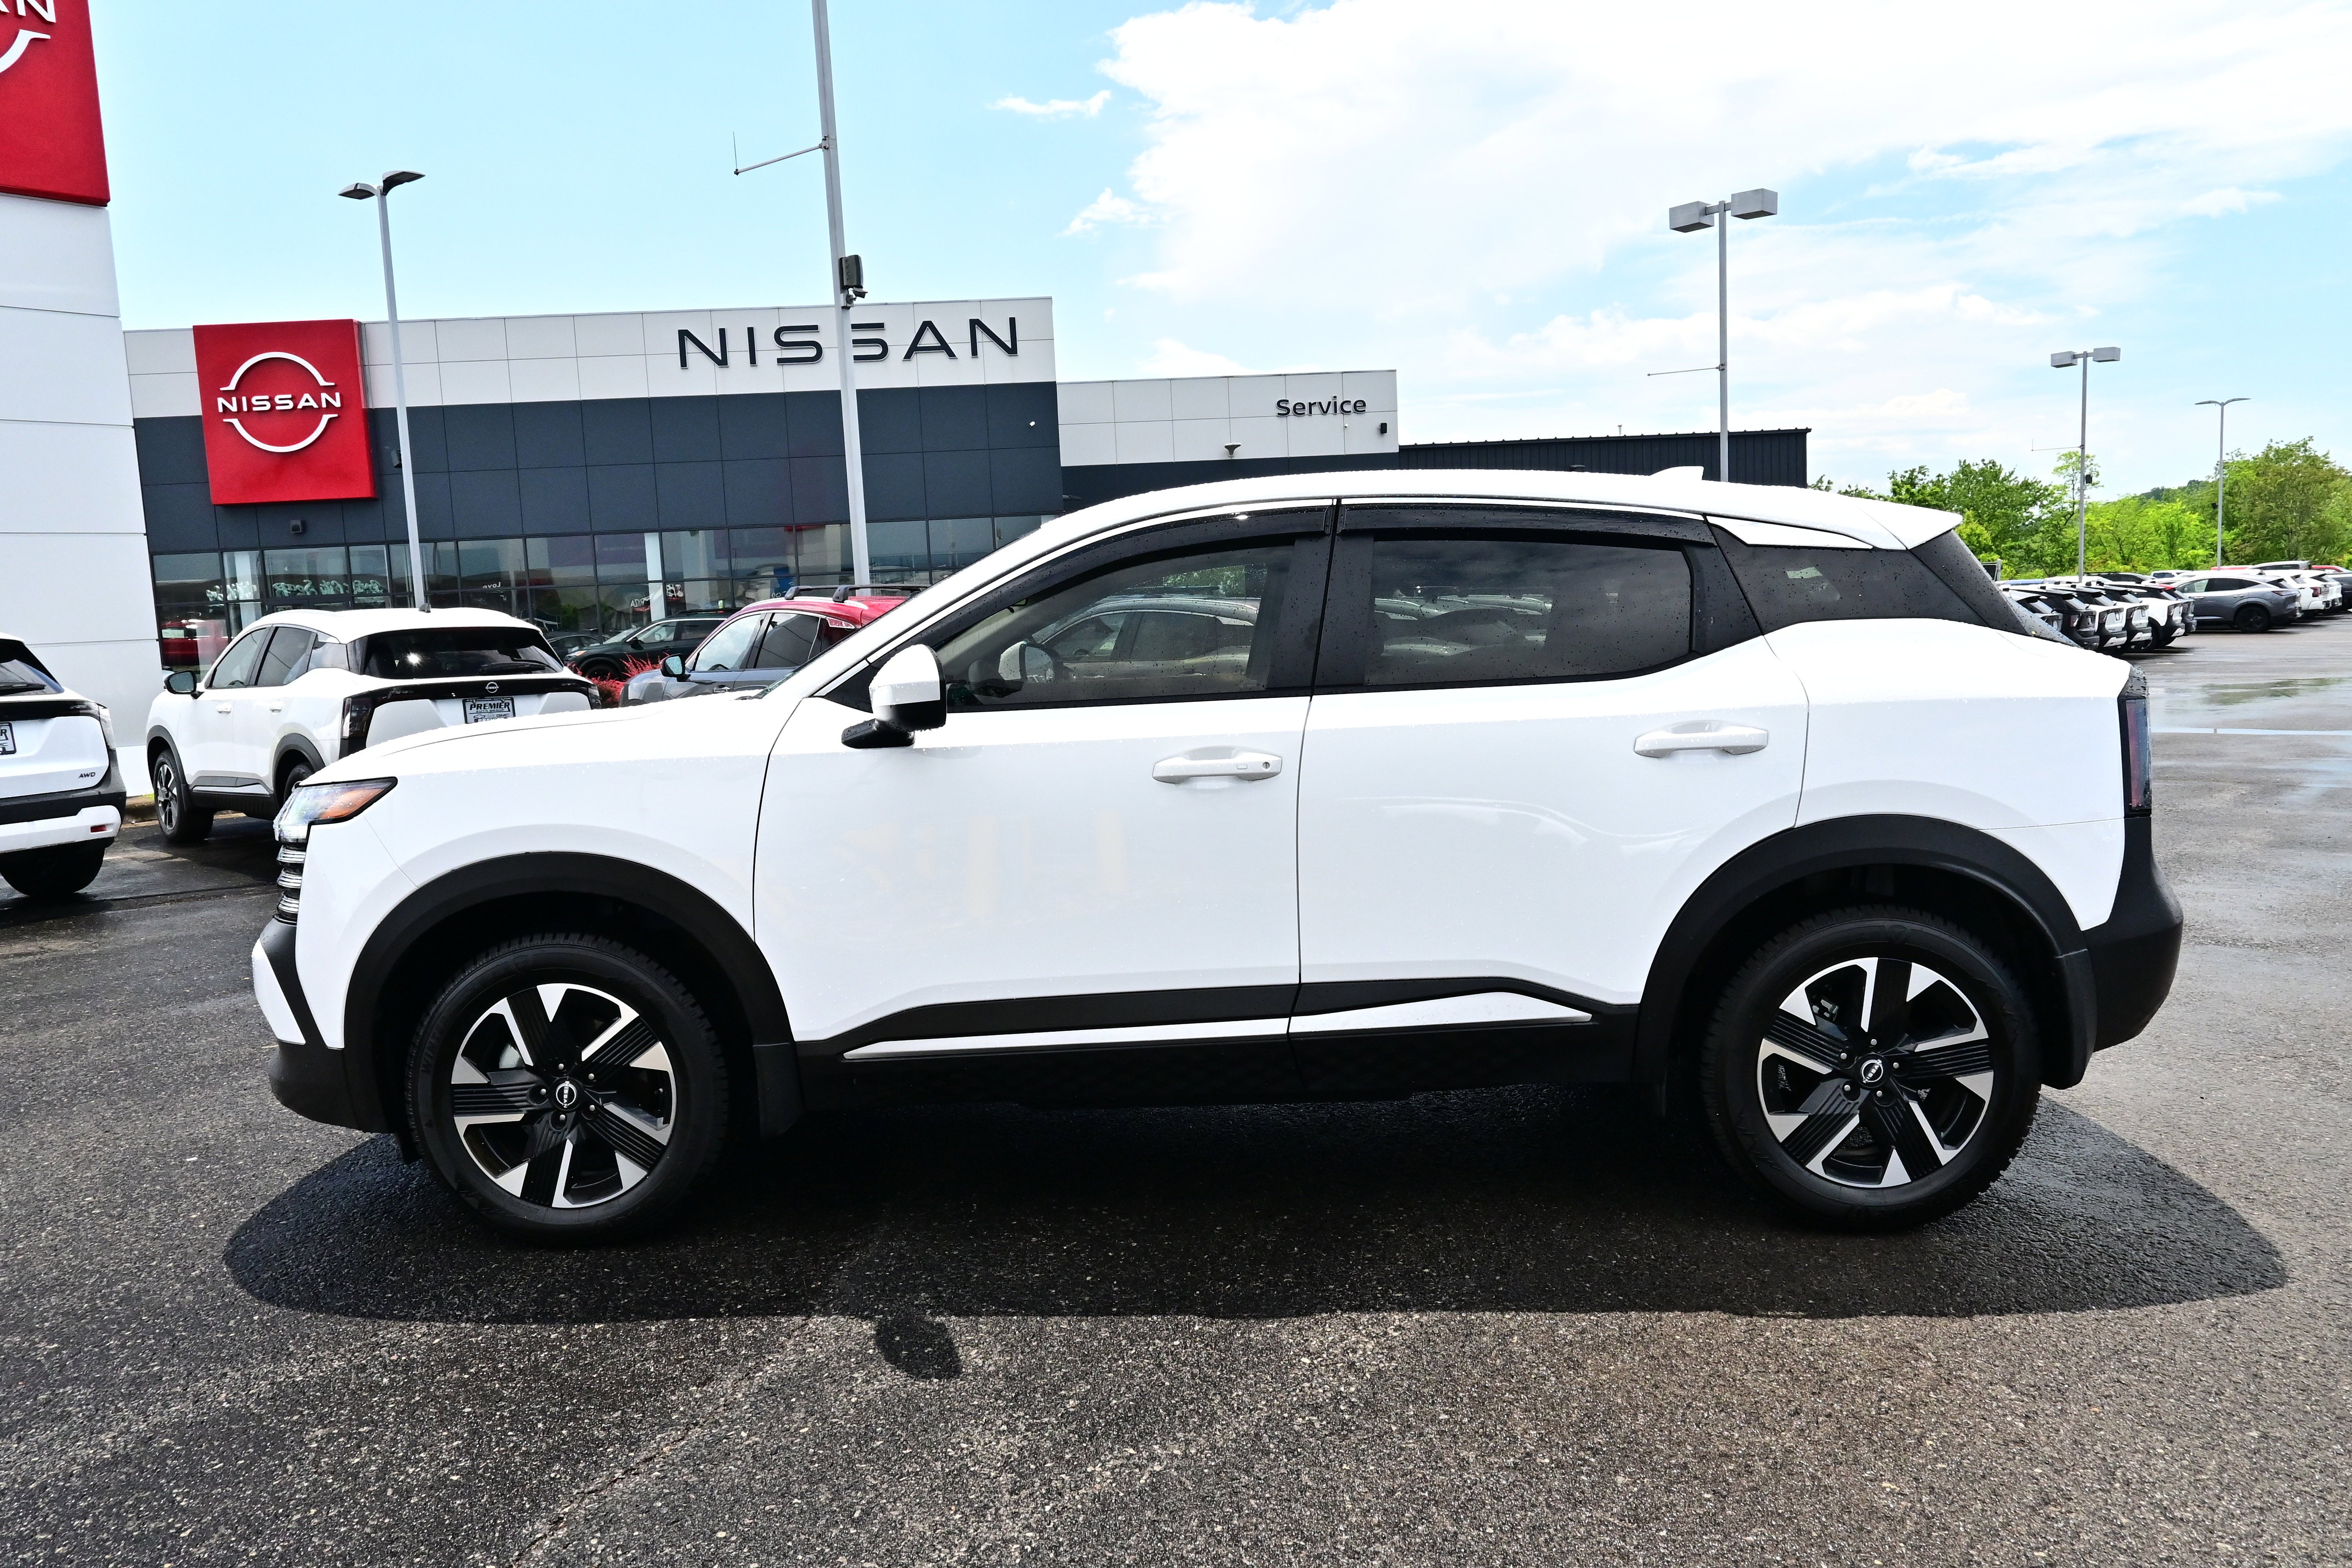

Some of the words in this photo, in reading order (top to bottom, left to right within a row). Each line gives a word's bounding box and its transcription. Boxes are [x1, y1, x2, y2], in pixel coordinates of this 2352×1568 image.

[678, 316, 1018, 369] NISSAN
[217, 392, 341, 413] NISSAN
[1276, 395, 1367, 417] Service
[470, 702, 511, 712] PREMIER
[1862, 1059, 1882, 1083] NISSAN
